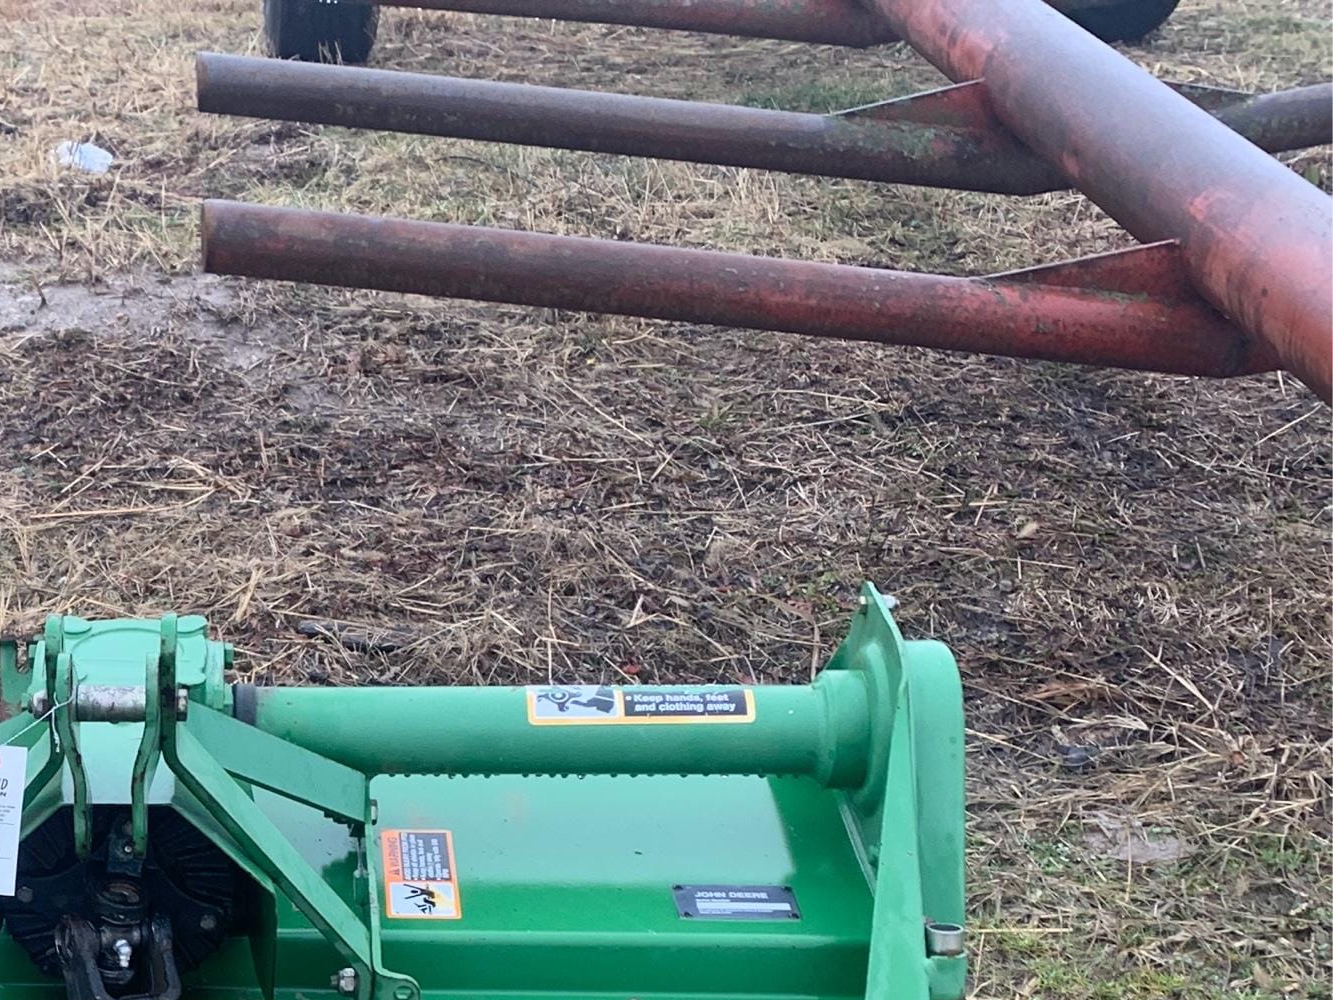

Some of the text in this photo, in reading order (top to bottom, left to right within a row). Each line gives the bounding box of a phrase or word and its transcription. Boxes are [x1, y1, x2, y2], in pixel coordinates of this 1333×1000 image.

[634, 693, 729, 703] Keep hands, feet
[634, 702, 736, 713] and clothing away
